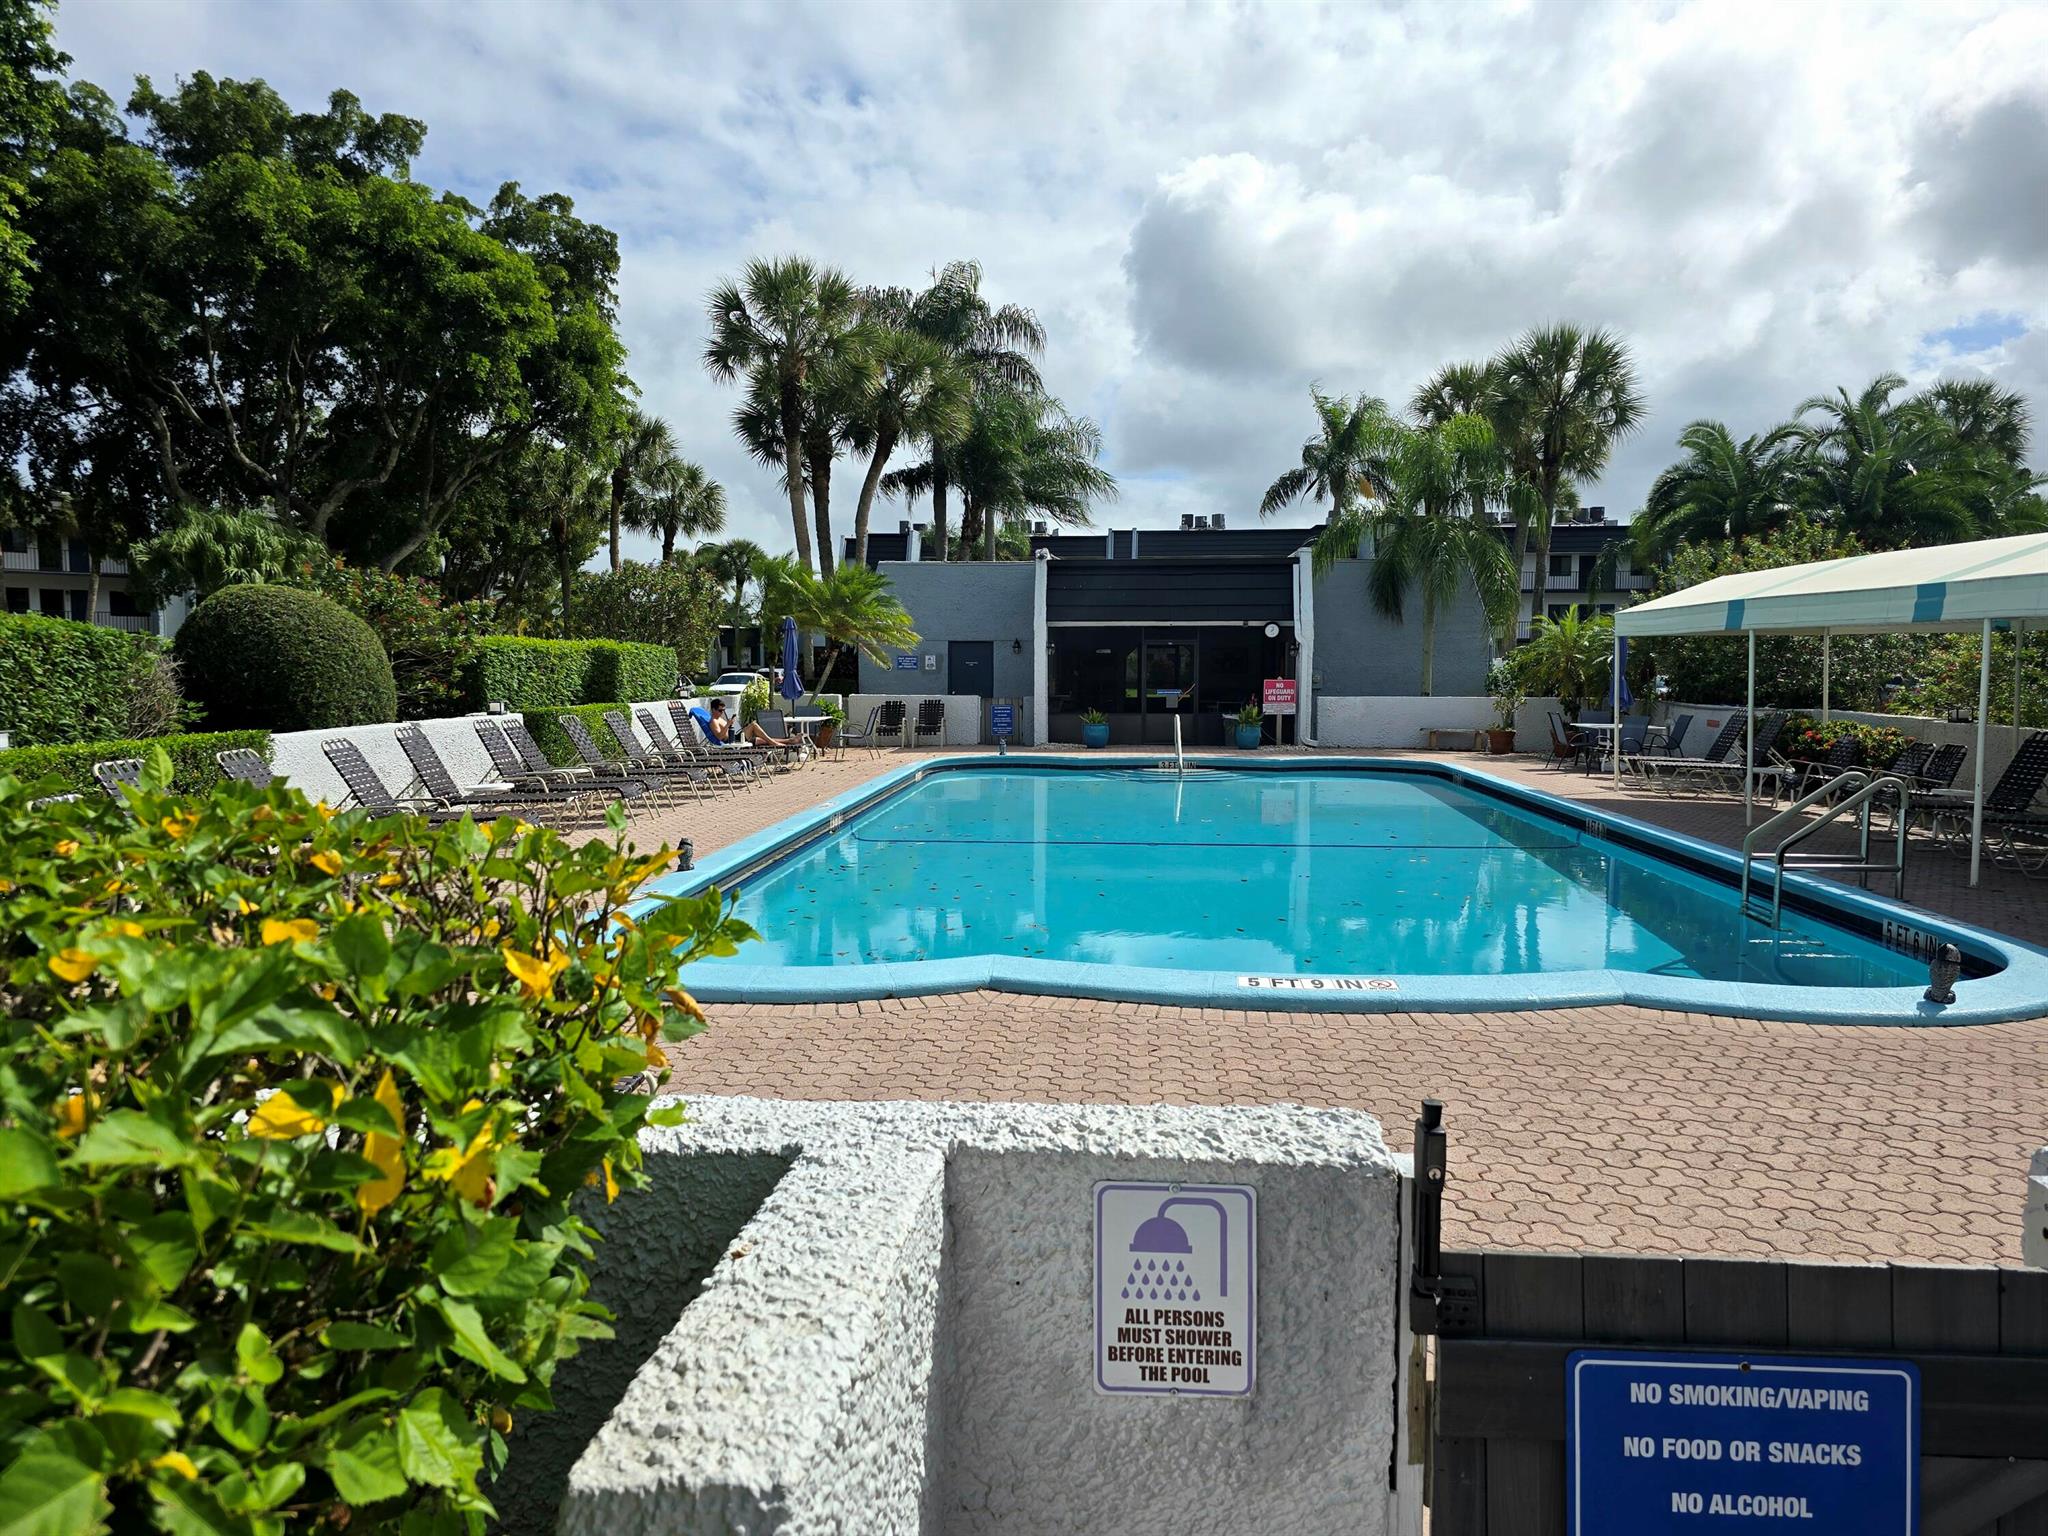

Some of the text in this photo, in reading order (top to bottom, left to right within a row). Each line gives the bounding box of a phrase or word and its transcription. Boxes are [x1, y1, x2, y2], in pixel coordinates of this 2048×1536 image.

[1897, 925, 1910, 944] FT
[1925, 934, 1937, 953] IN
[1247, 977, 1260, 987] 5
[1271, 978, 1299, 988] FT
[1310, 980, 1324, 989] 9
[1336, 980, 1363, 989] IN
[1125, 1308, 1225, 1328] ALL PERSONS
[1117, 1327, 1232, 1347] MUST SHOWER
[1107, 1346, 1242, 1366] BEFORE ENTERING
[1139, 1366, 1210, 1383] THE POOL
[1630, 1382, 1869, 1412] NO SMOKING/VAPING
[1623, 1436, 1862, 1466] NO FOOD OR SNACKS
[1671, 1492, 1813, 1519] NO ALCOHOL
